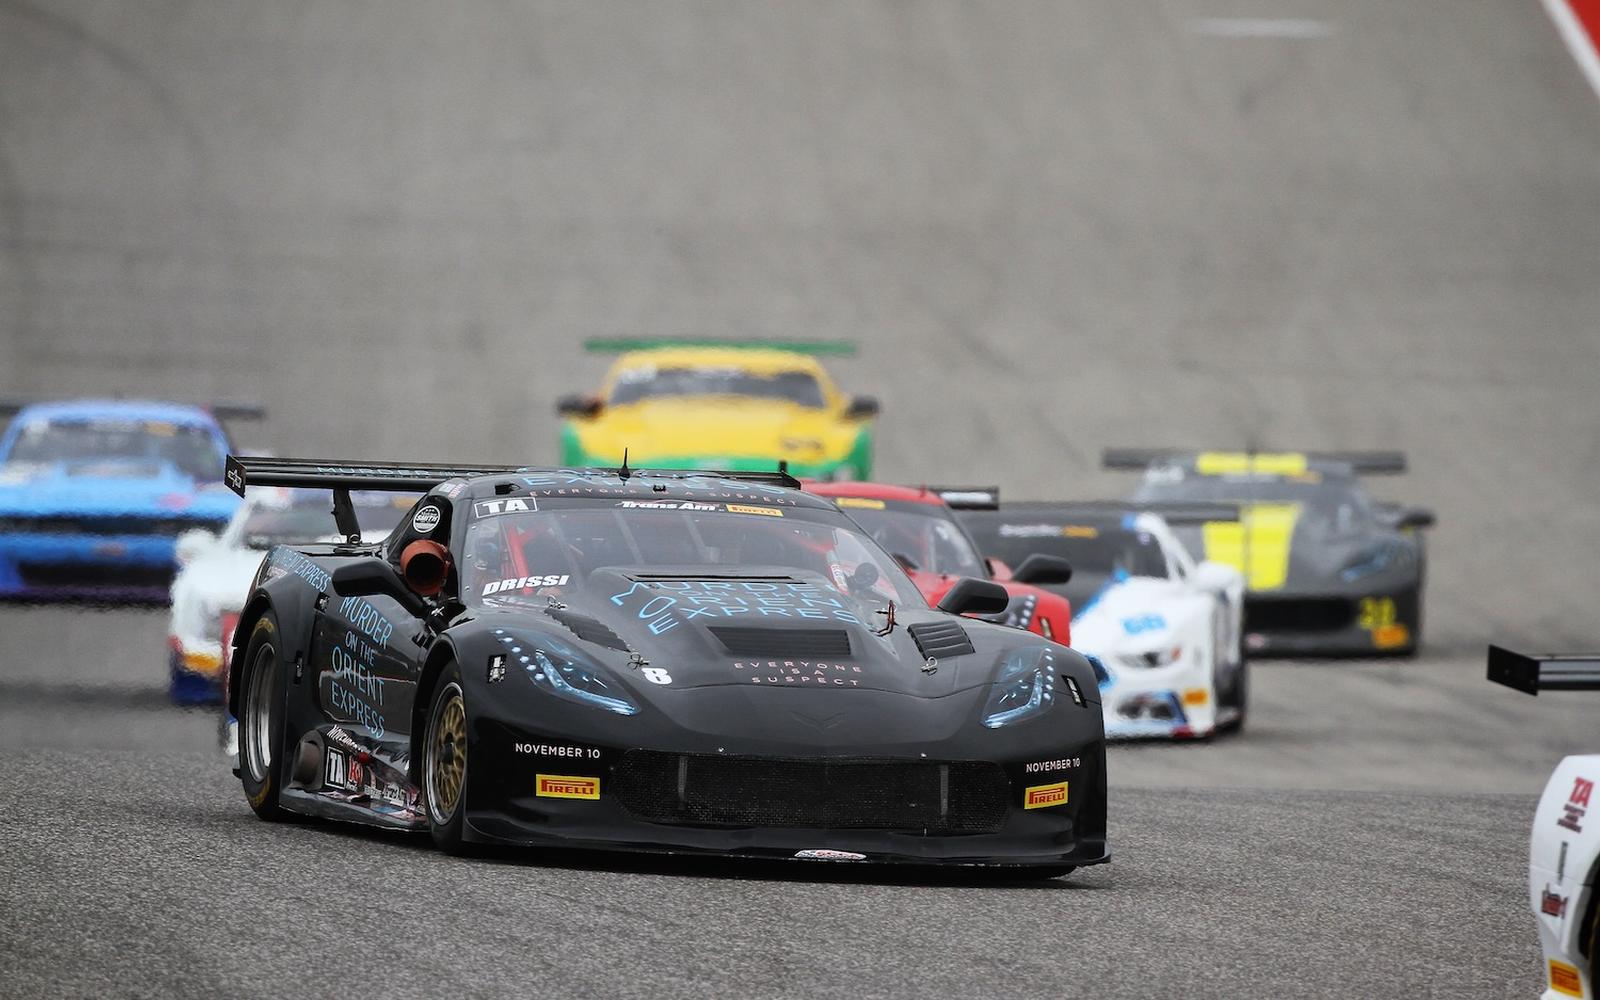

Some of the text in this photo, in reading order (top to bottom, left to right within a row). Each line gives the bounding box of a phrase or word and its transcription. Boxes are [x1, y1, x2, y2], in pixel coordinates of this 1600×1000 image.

[482, 499, 530, 514] TA
[708, 492, 797, 506] SUSPECT
[294, 559, 332, 593] EXPRESS
[481, 574, 570, 597] DRISSI
[638, 596, 844, 619] ORIEN
[340, 596, 393, 650] MURDER
[647, 606, 862, 635] EXPRES
[345, 630, 377, 667] ON THE
[332, 646, 385, 706] ORIENT
[642, 667, 673, 685] 8
[734, 661, 862, 674] EVERYONE
[751, 676, 860, 687] SUSPECT
[331, 681, 385, 739] EXPRESS
[515, 742, 601, 759] NOVEMBER 10
[329, 751, 345, 785] TA
[1026, 757, 1081, 773] NOVEMBER 10
[540, 778, 595, 795] PIRELLI
[1028, 786, 1066, 805] PIRELLI
